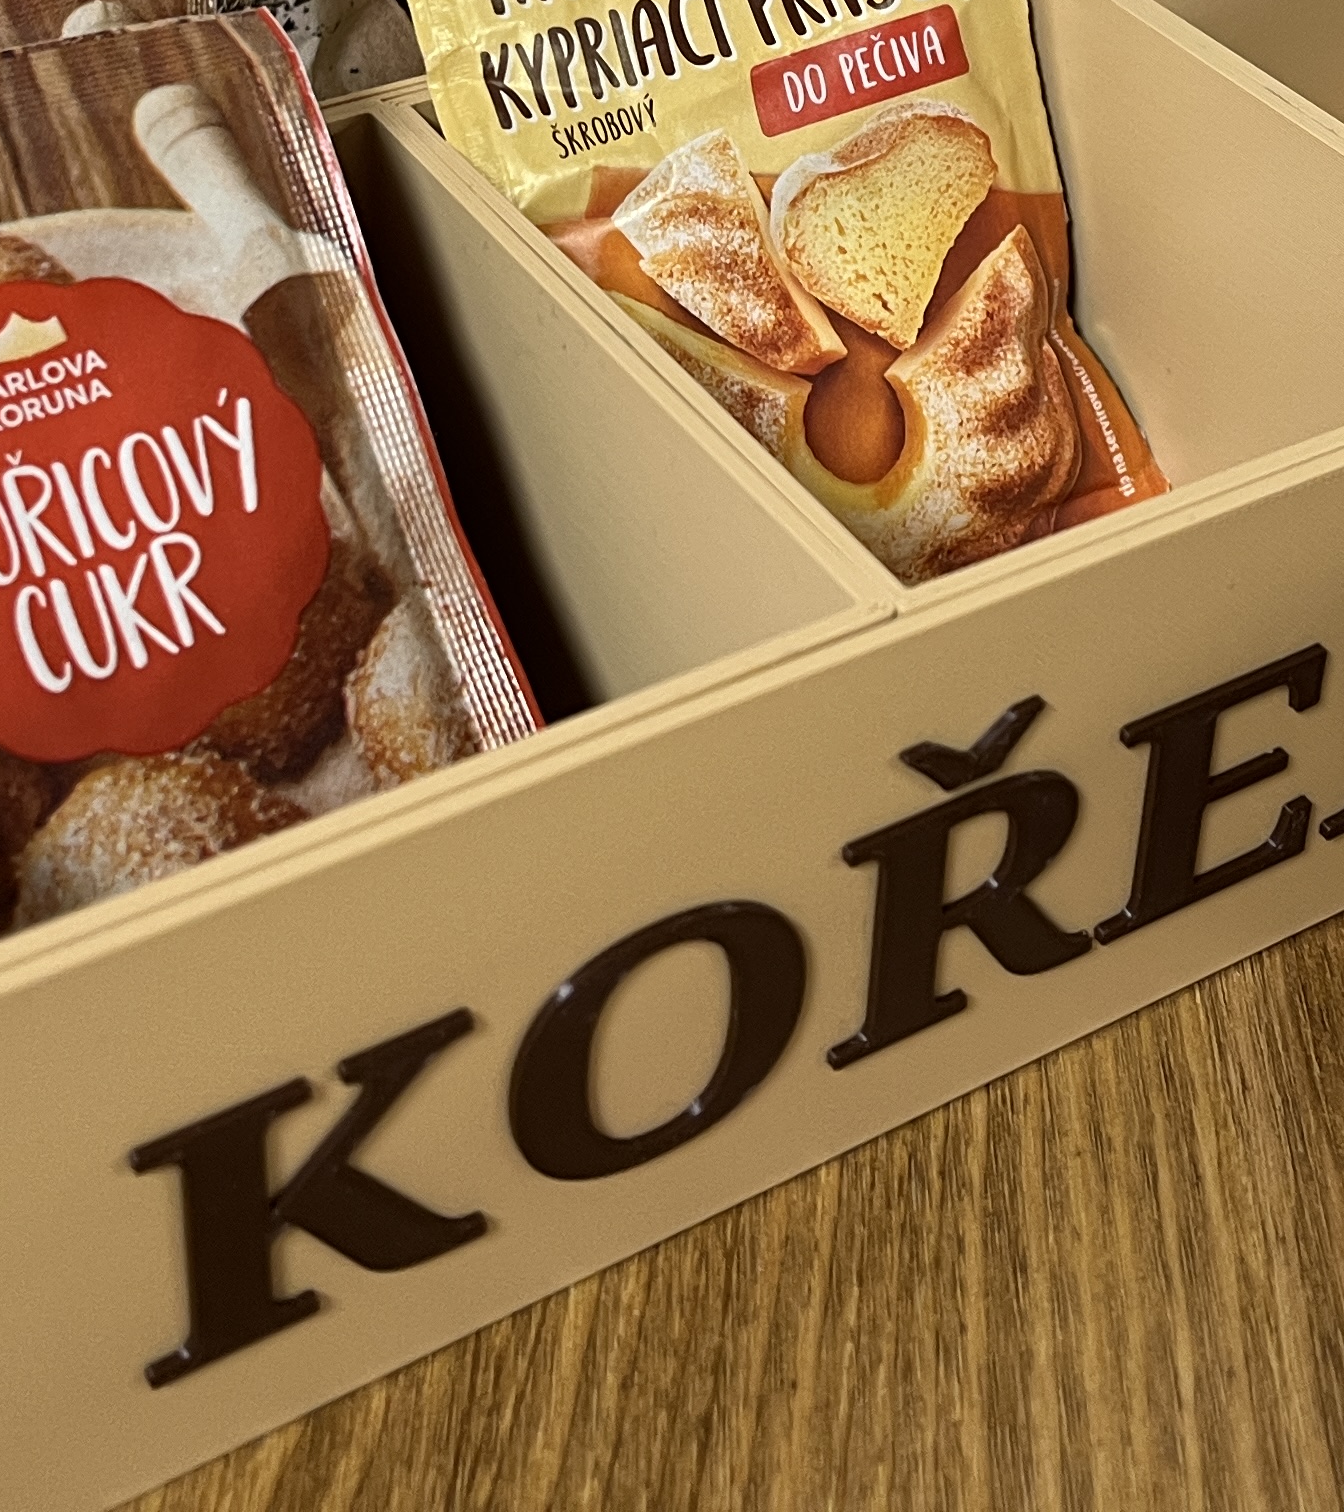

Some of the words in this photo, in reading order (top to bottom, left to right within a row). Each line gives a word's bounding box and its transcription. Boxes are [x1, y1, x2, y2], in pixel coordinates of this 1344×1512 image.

[782, 66, 828, 114] DO
[839, 24, 947, 98] PEČIVA
[551, 94, 657, 160] ŠKROBOVÝ
[1112, 453, 1128, 475] na
[13, 534, 227, 694] CUKR
